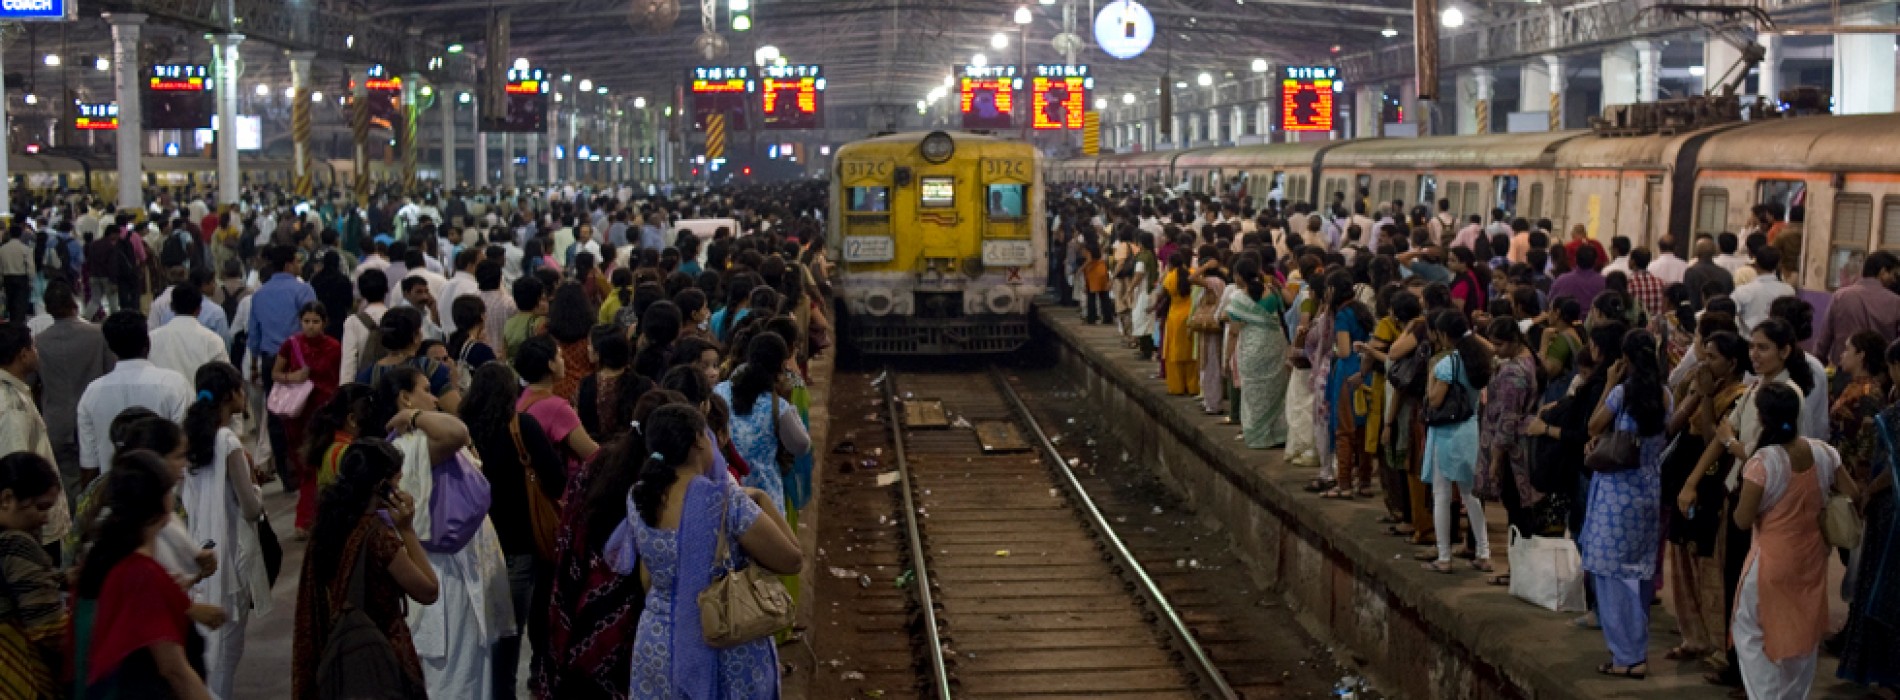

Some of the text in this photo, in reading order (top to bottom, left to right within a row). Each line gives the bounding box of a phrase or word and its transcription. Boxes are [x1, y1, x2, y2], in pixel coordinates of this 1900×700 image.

[2, 0, 52, 10] COACH
[849, 161, 886, 176] 312C
[986, 160, 1024, 176] 312C
